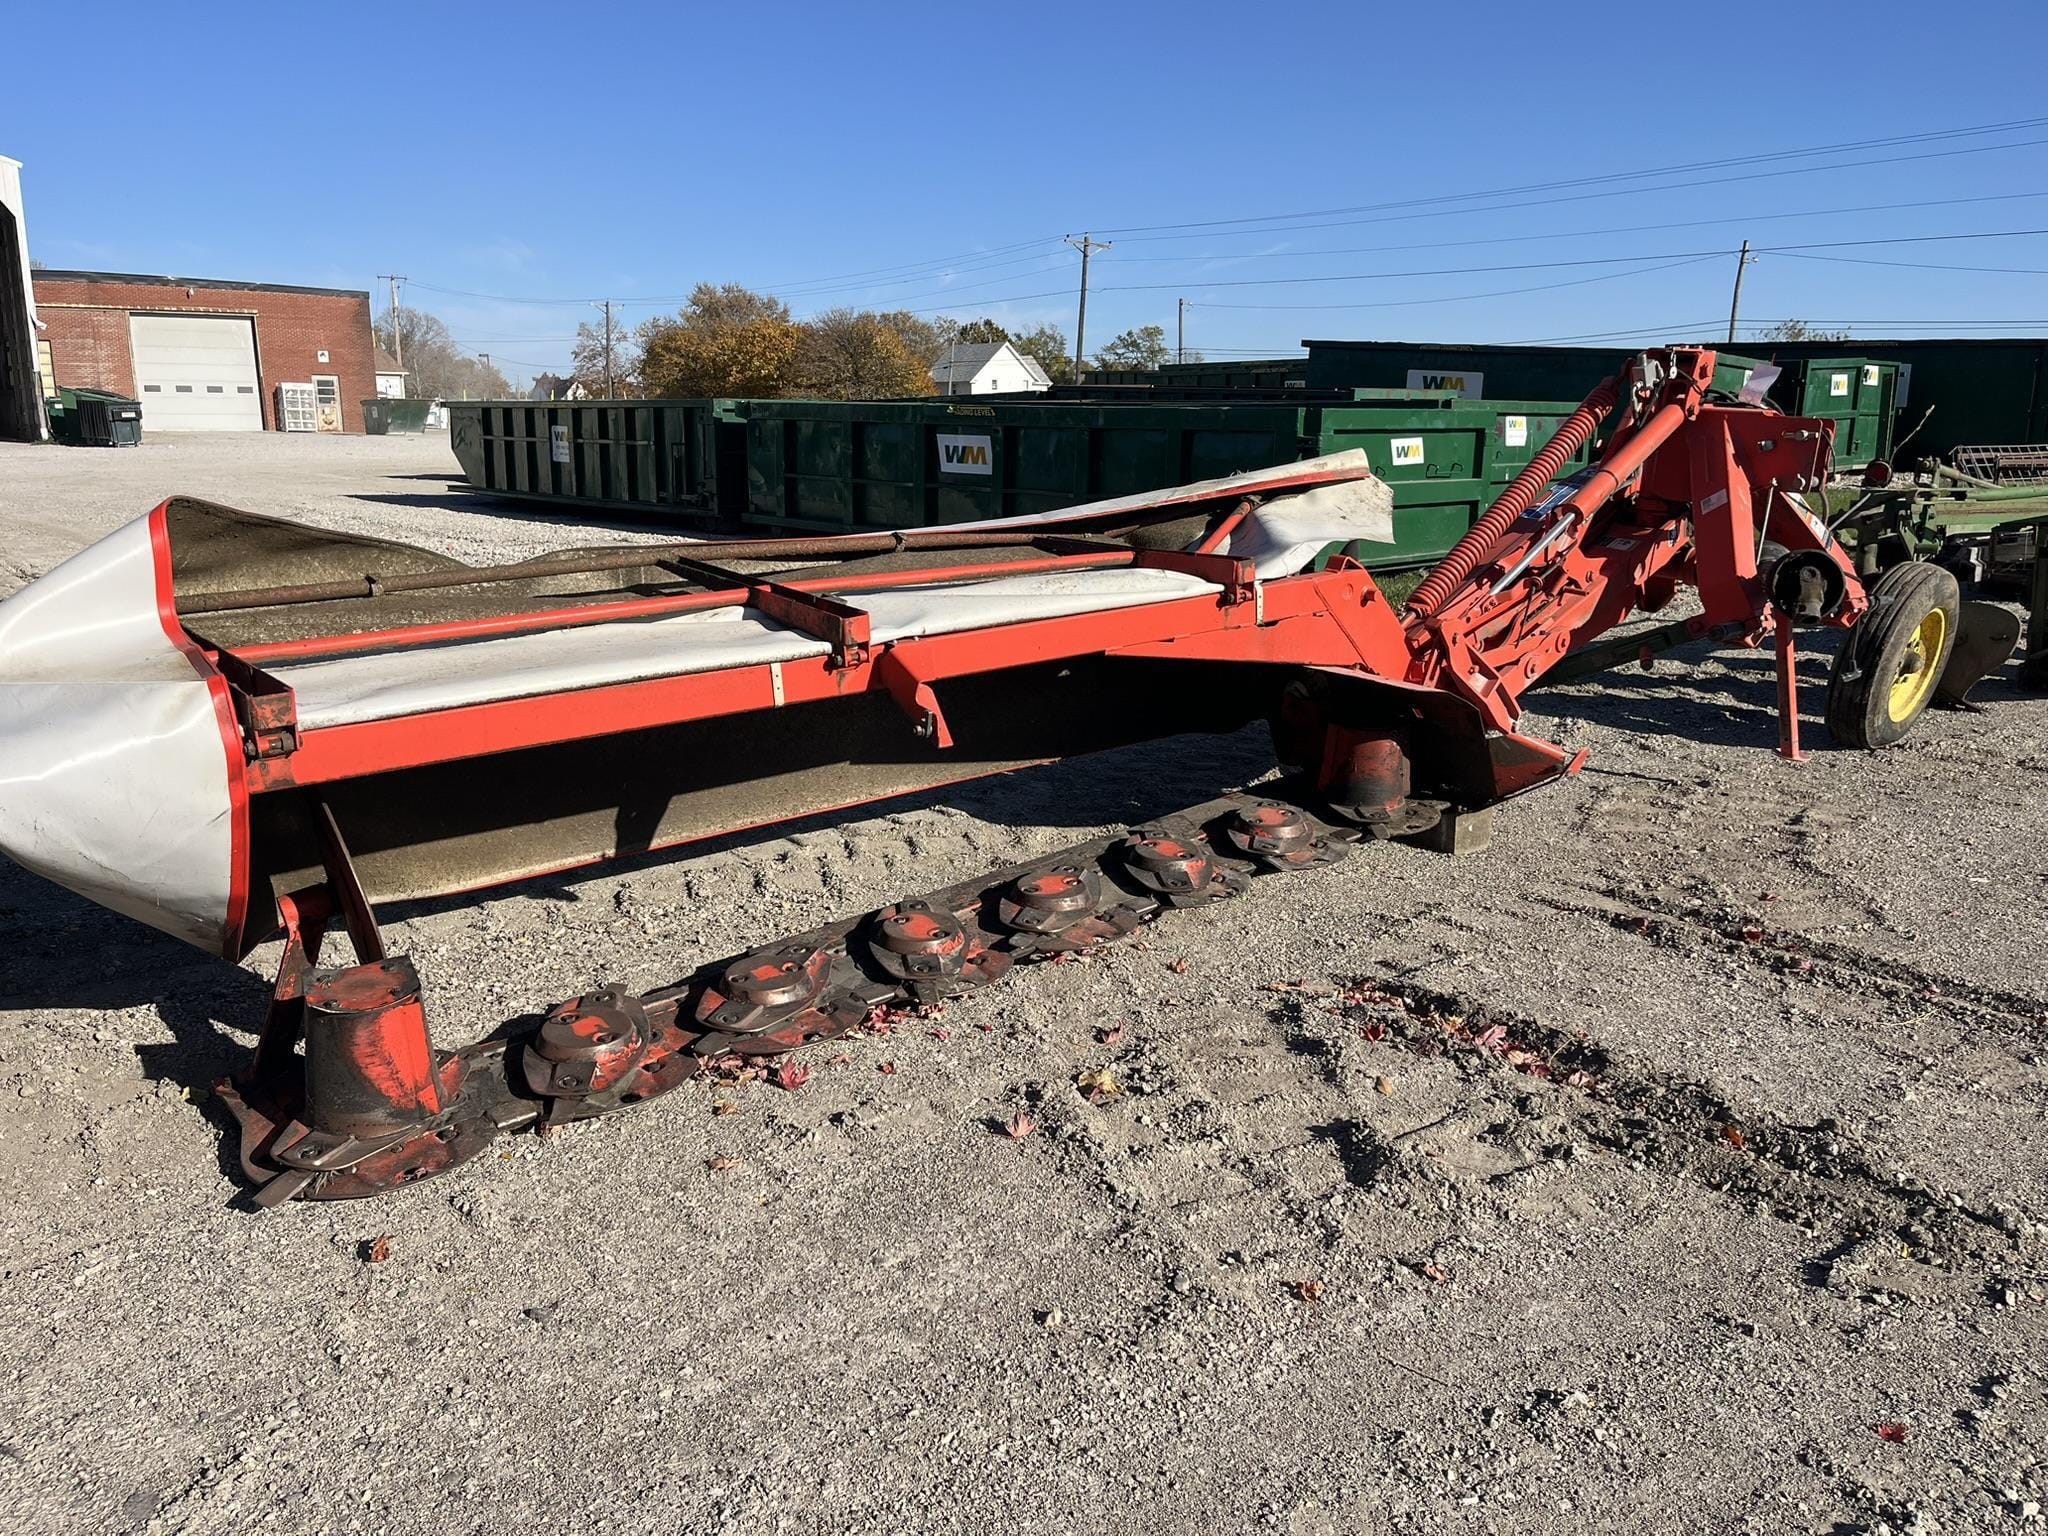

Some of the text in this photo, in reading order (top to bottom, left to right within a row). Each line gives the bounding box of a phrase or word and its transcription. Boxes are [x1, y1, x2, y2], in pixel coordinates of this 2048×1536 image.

[1423, 375, 1465, 391] WM
[945, 445, 988, 465] WM
[1396, 444, 1420, 458] WM
